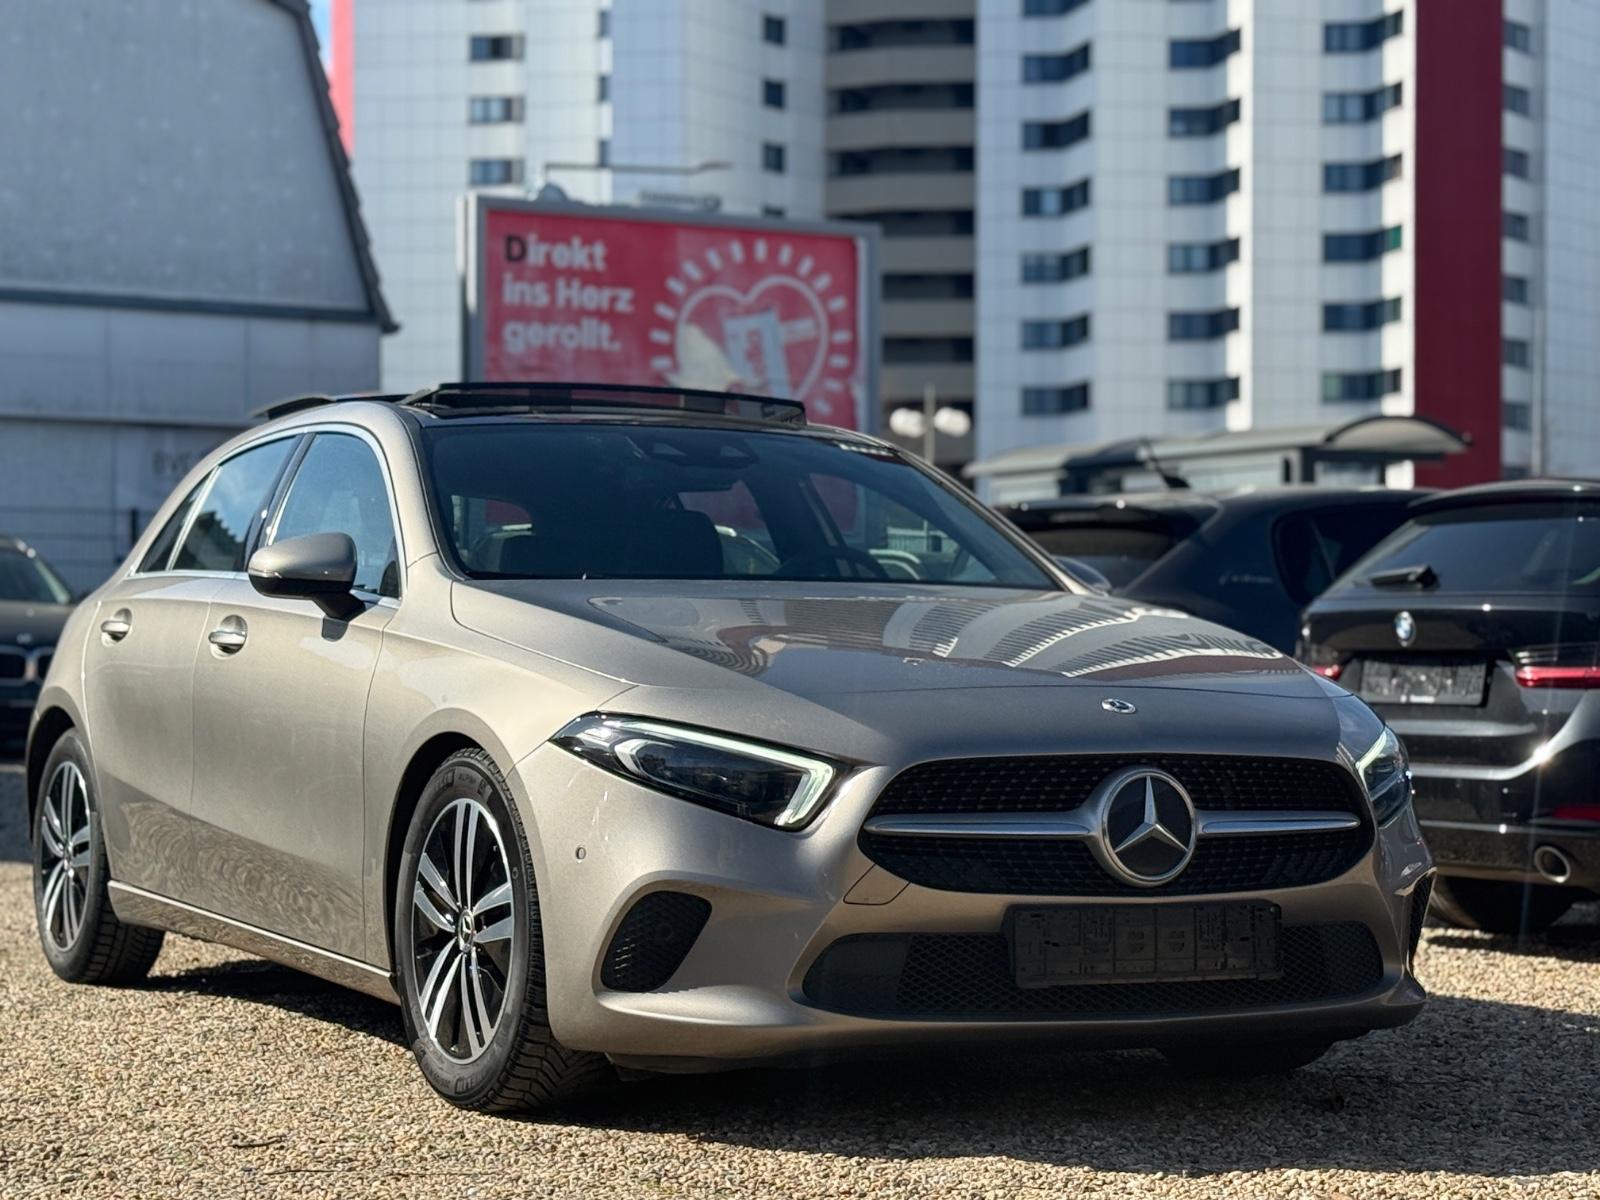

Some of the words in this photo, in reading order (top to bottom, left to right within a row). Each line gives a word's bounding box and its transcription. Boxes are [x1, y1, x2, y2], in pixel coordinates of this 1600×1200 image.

[504, 233, 607, 271] Direkt
[503, 271, 549, 306] ins
[555, 277, 635, 313] Herz
[503, 316, 622, 353] gerollt.
